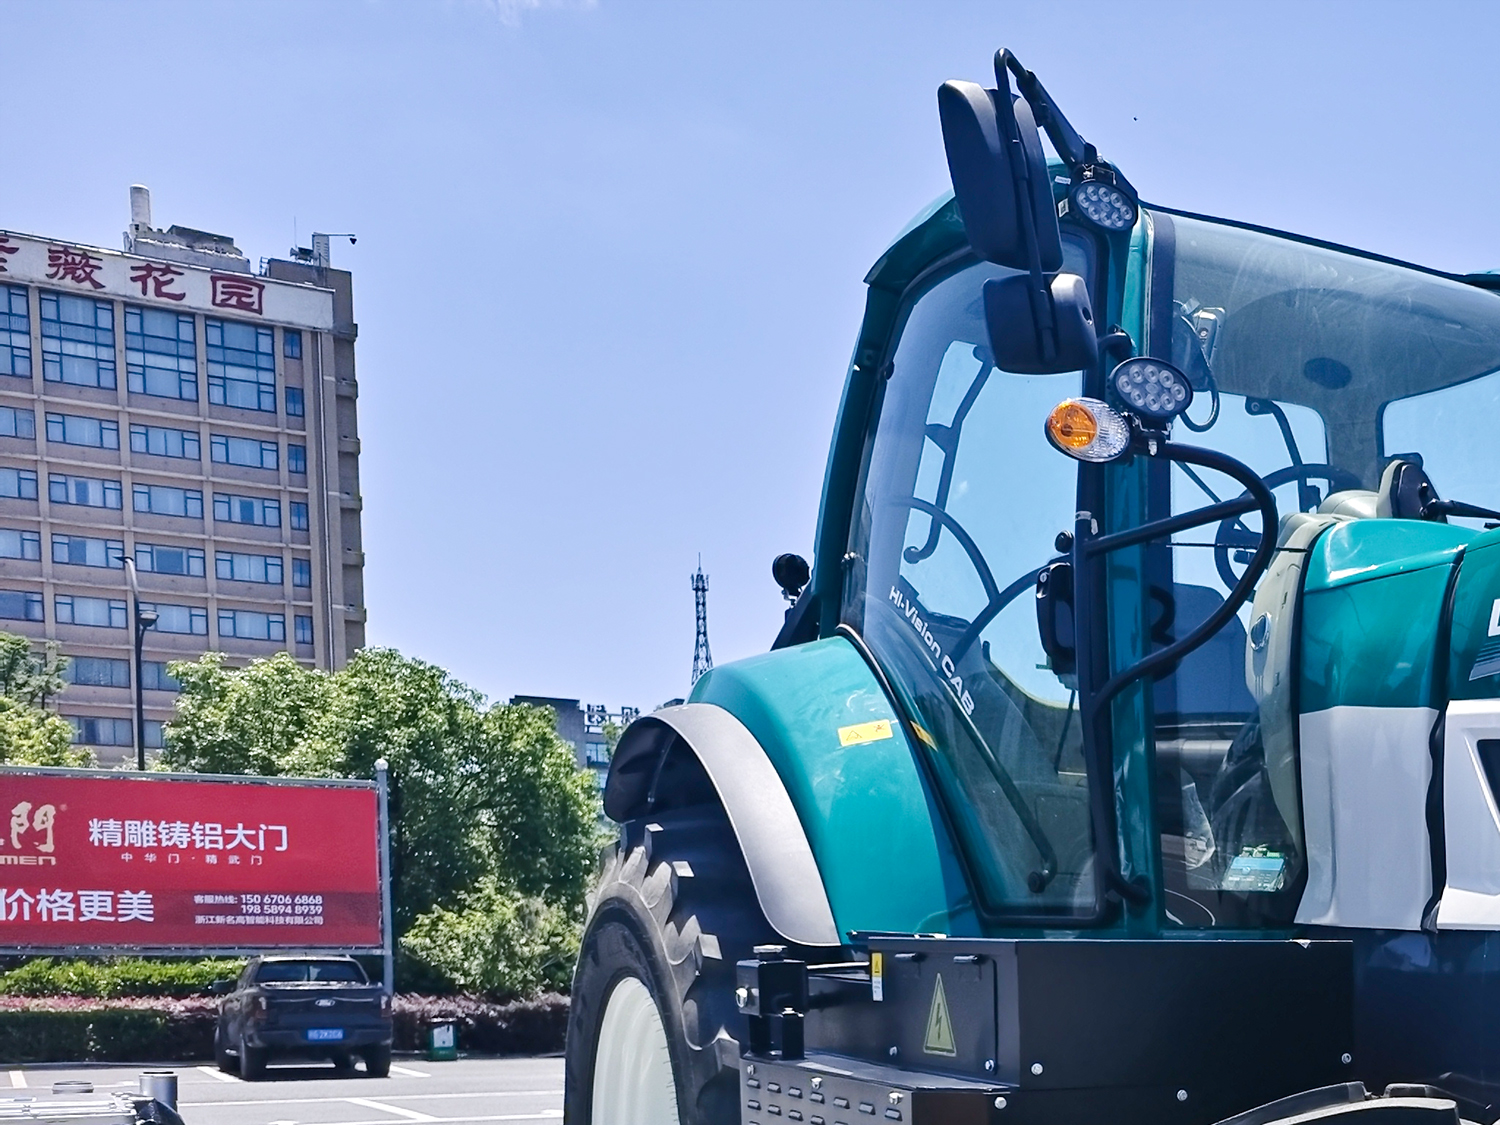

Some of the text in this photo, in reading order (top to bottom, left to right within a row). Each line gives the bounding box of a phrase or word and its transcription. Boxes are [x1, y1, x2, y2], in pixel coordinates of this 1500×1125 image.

[941, 656, 975, 716] CAB
[0, 800, 56, 853] 門
[88, 817, 288, 852] 精雕铸铝大门
[0, 888, 155, 922] 价格更美
[240, 894, 261, 904] 150
[263, 894, 292, 904] 6706
[294, 895, 323, 905] 6868
[241, 904, 261, 914] 198
[263, 905, 292, 915] 5894
